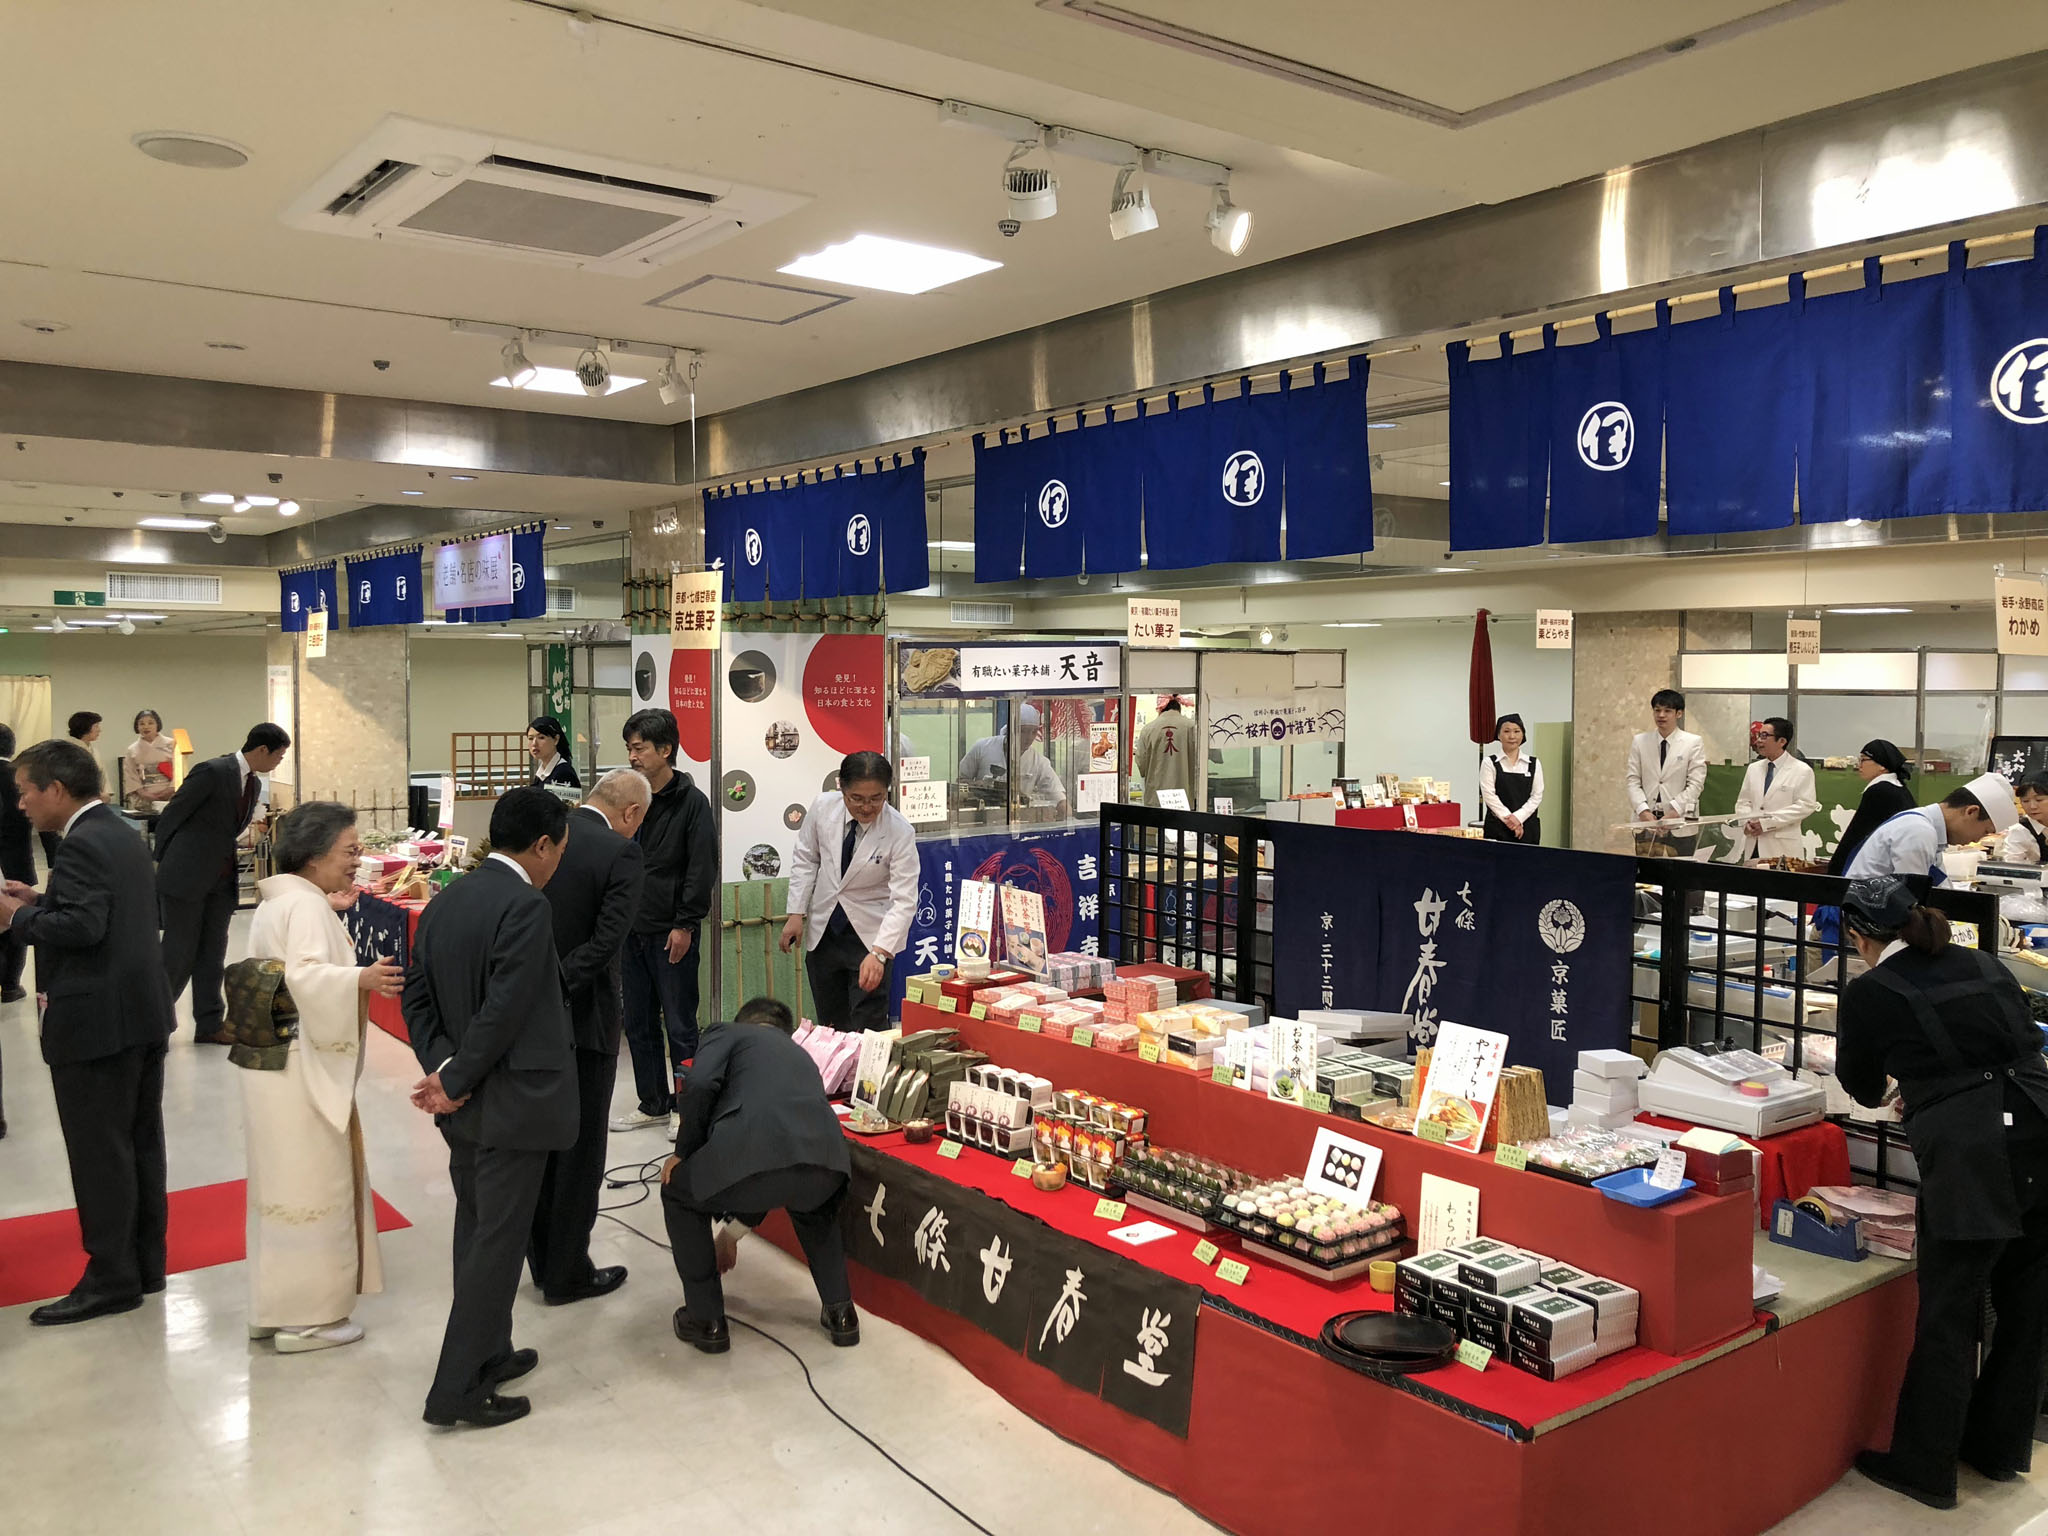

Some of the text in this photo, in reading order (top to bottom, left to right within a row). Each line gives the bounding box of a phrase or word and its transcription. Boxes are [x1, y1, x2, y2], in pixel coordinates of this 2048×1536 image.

[674, 610, 716, 631] 京生菓子
[2009, 616, 2040, 636] わかめ
[1134, 622, 1175, 638] たい菓子
[1538, 628, 1570, 639] 栗どらやき
[834, 673, 857, 683] 発見！
[674, 687, 707, 696] 知るほどに深まる
[813, 686, 876, 695] 知るほどに深まる
[675, 700, 705, 709] 日本の食と文化
[816, 698, 872, 707] 日本の食と文化
[1456, 881, 1476, 931] 七條
[1319, 911, 1334, 1011] 京・三十三間
[1551, 959, 1569, 1042] 京菓匠
[1289, 1026, 1303, 1080] お茶々餅
[1464, 1038, 1490, 1100] やすらい
